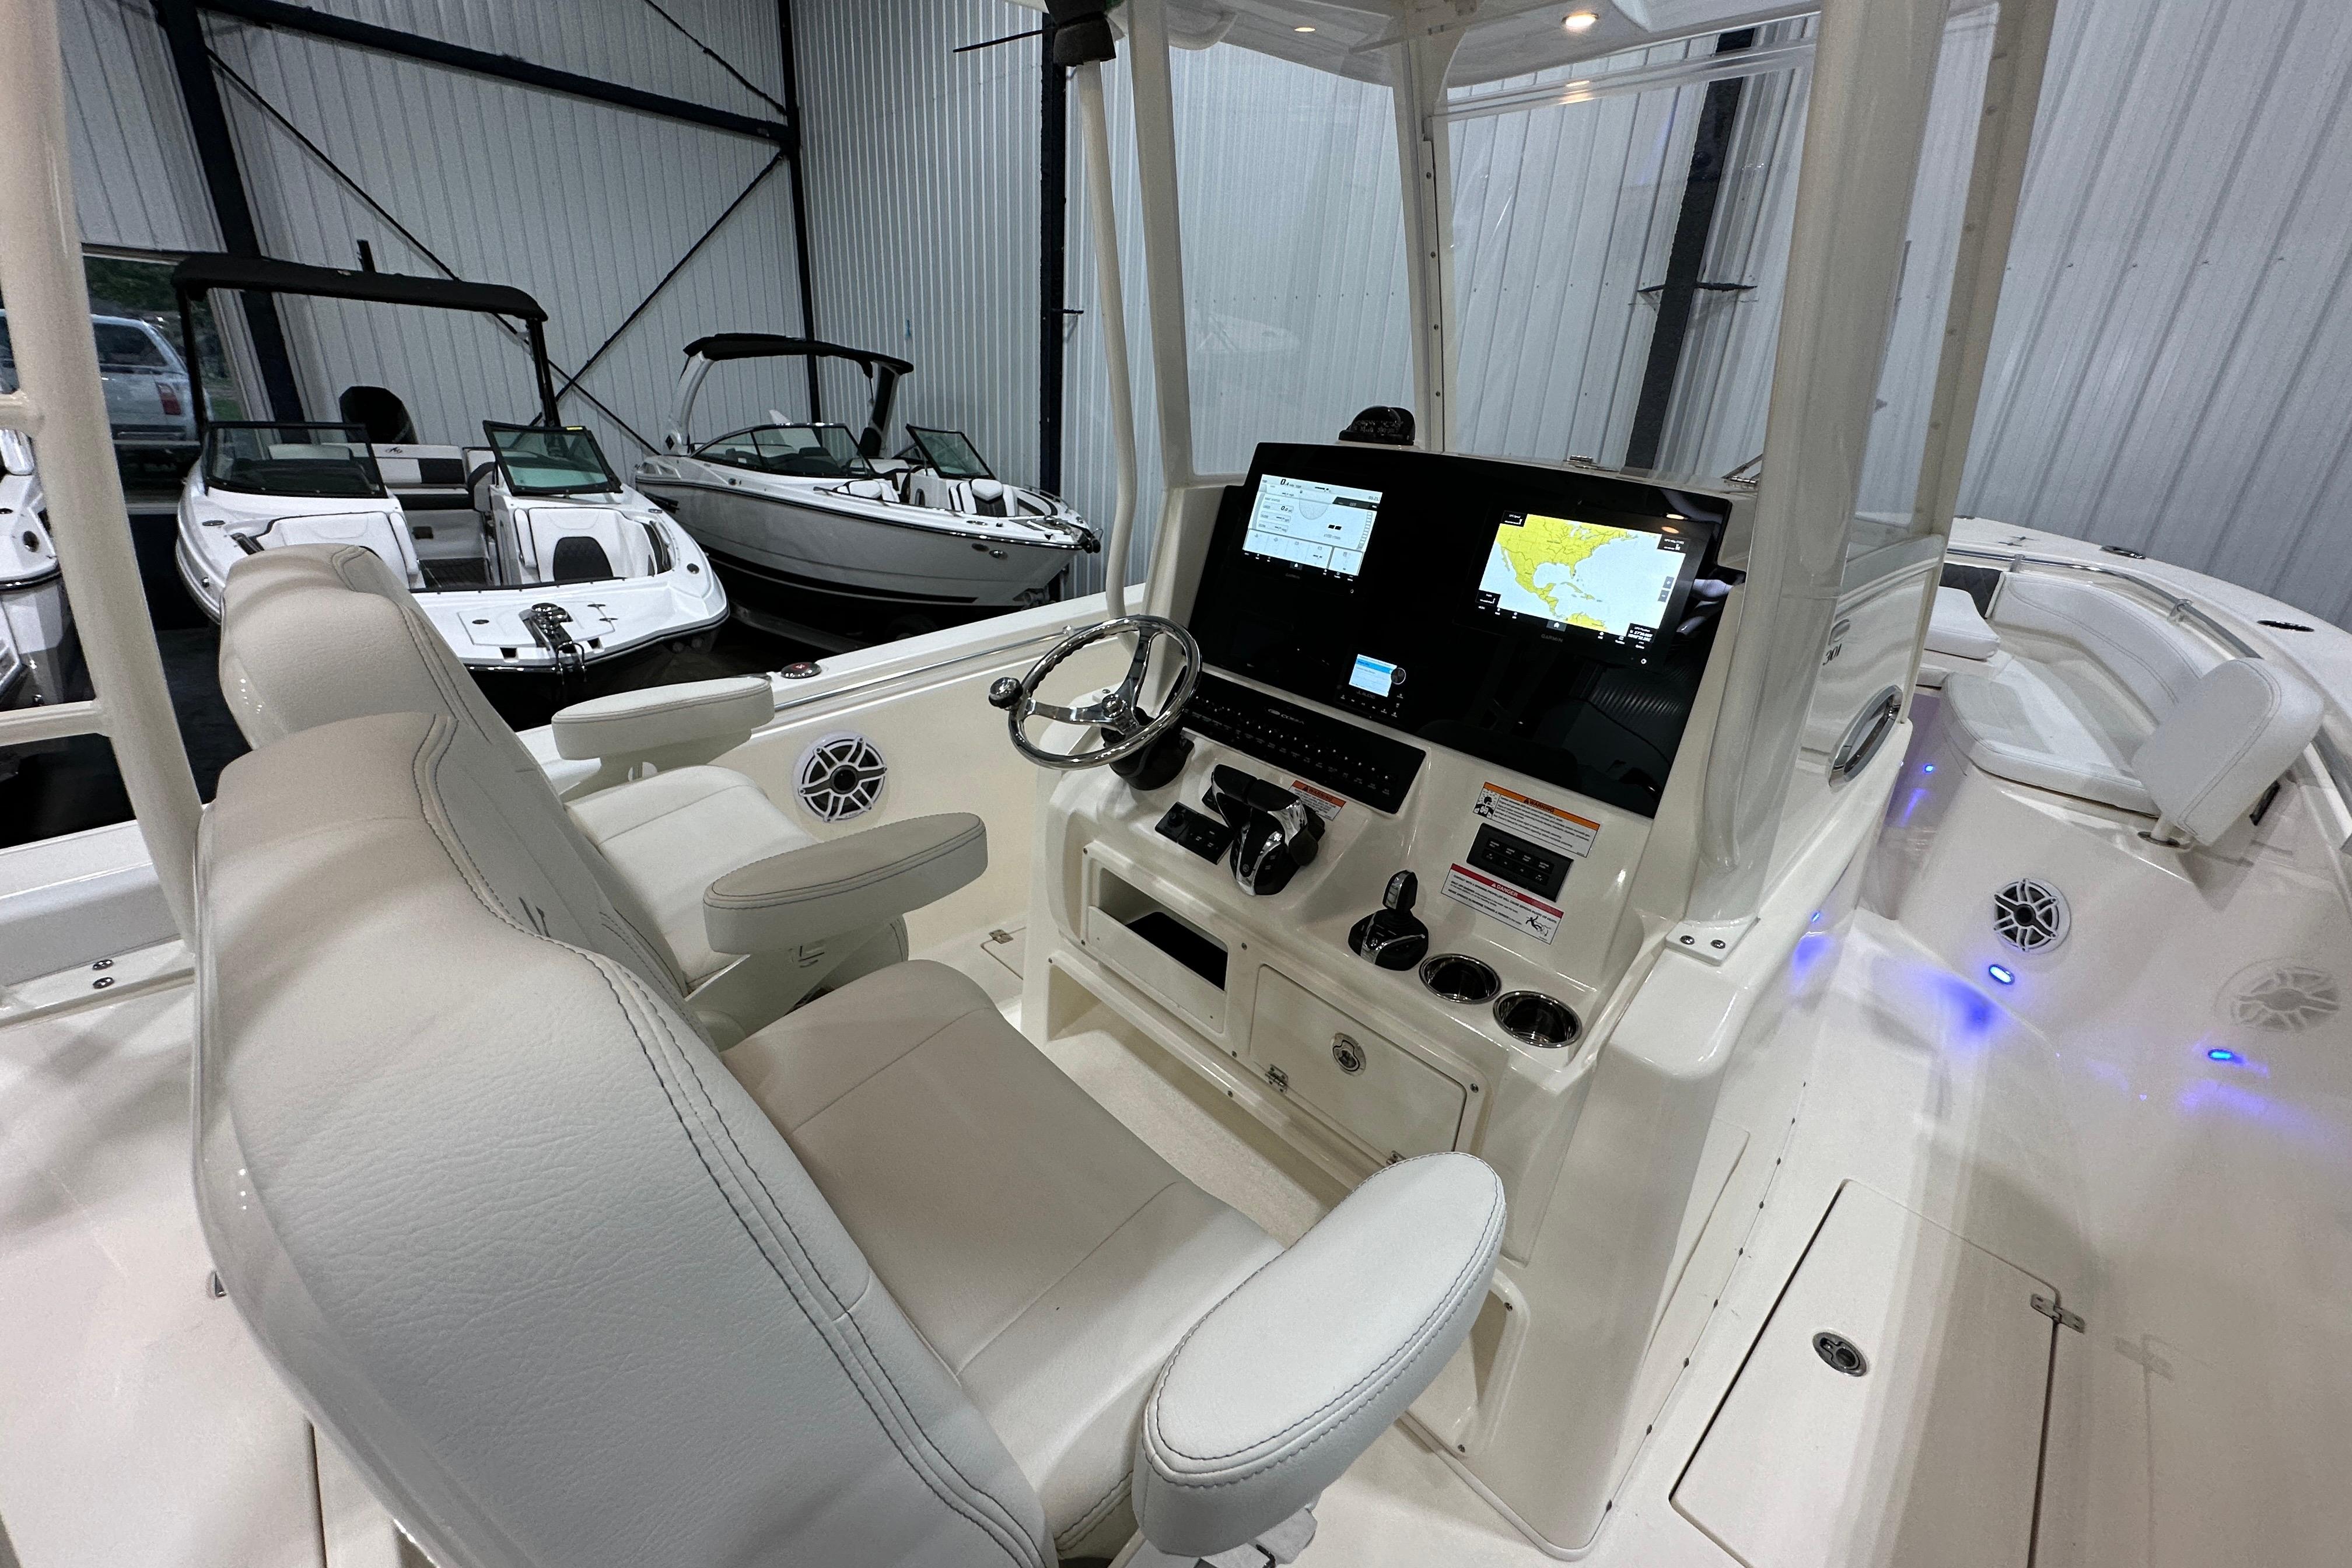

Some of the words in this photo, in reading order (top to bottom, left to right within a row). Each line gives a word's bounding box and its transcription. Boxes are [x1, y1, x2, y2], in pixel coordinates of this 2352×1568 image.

[1822, 643, 1842, 666] 301
[1528, 798, 1555, 813] WARNING
[1497, 884, 1518, 897] DANGER
